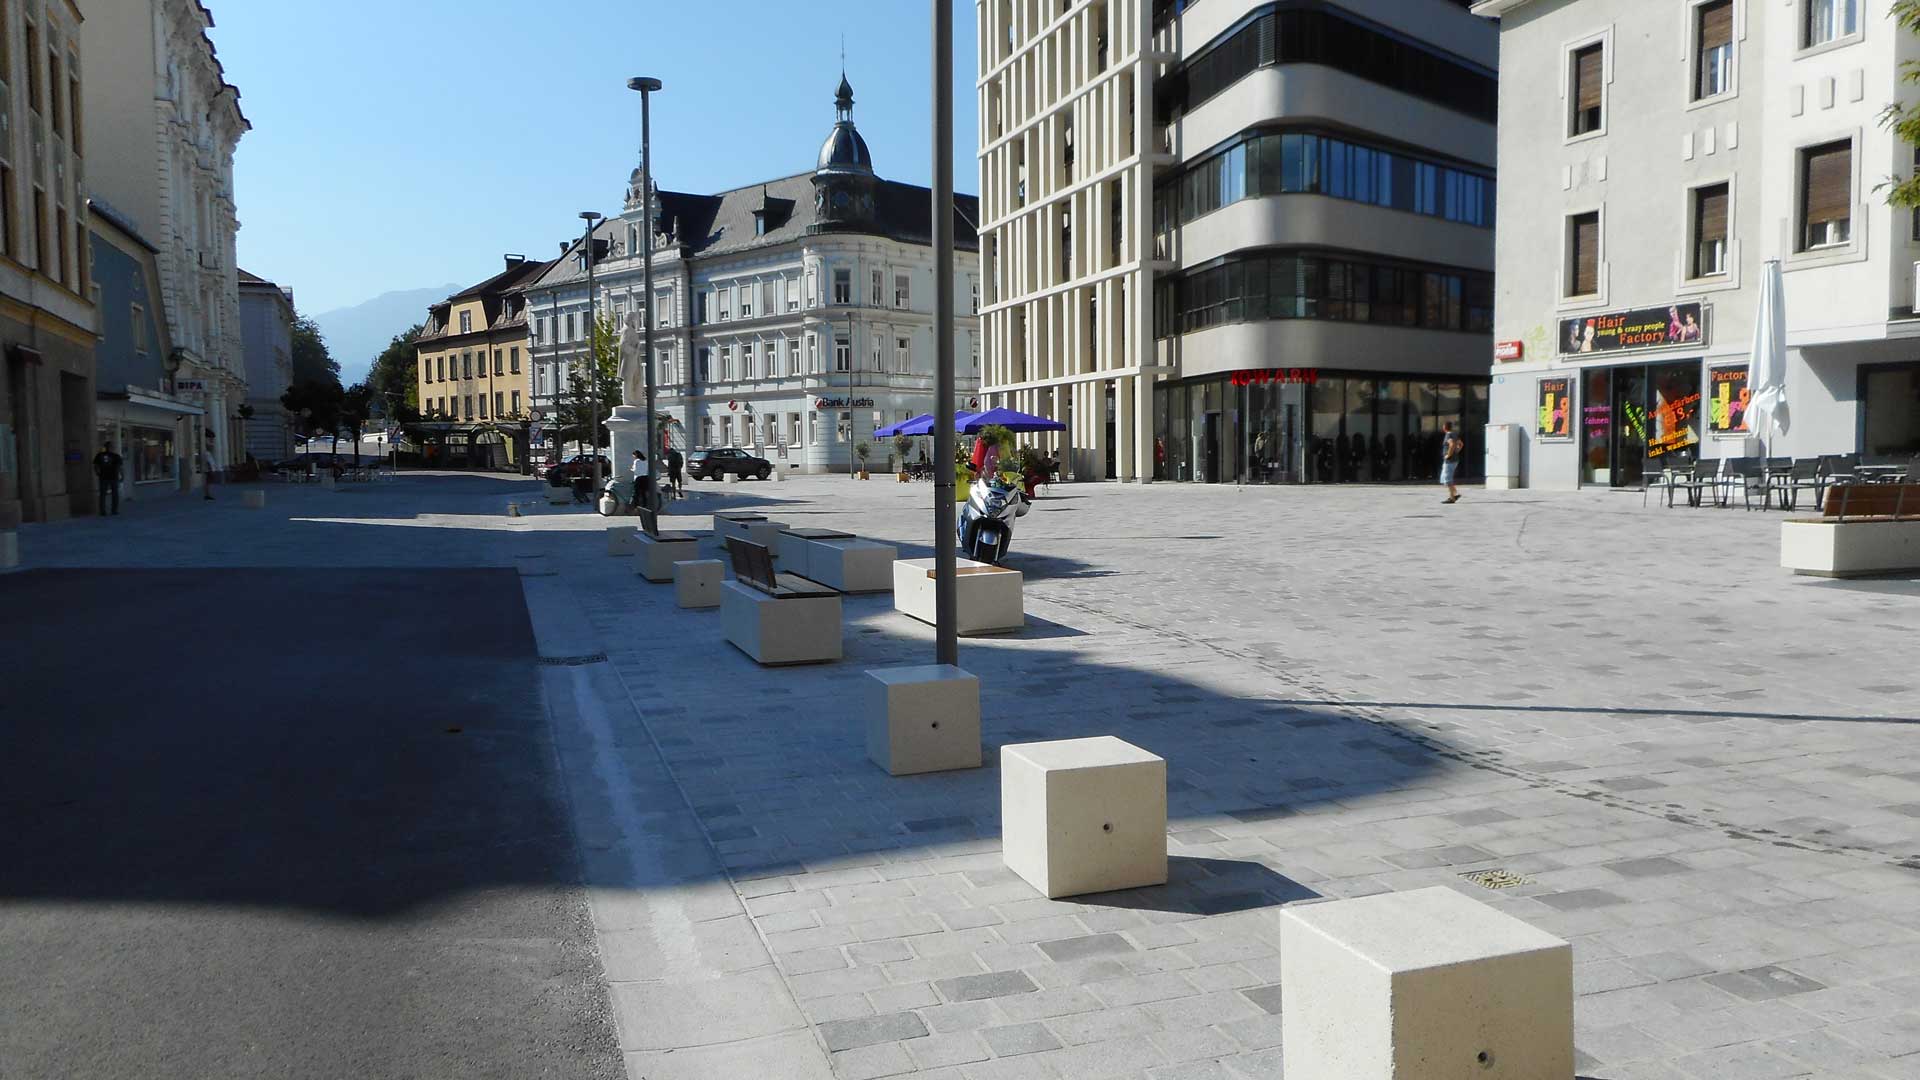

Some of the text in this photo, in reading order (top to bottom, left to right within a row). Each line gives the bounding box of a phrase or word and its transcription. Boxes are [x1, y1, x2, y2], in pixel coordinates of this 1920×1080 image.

[1598, 315, 1626, 329] Hair
[1597, 329, 1616, 338] young
[1624, 325, 1643, 333] crazy
[1643, 321, 1665, 333] people
[1619, 331, 1665, 344] Factory
[1544, 382, 1565, 392] Hair
[822, 397, 844, 407] Bank
